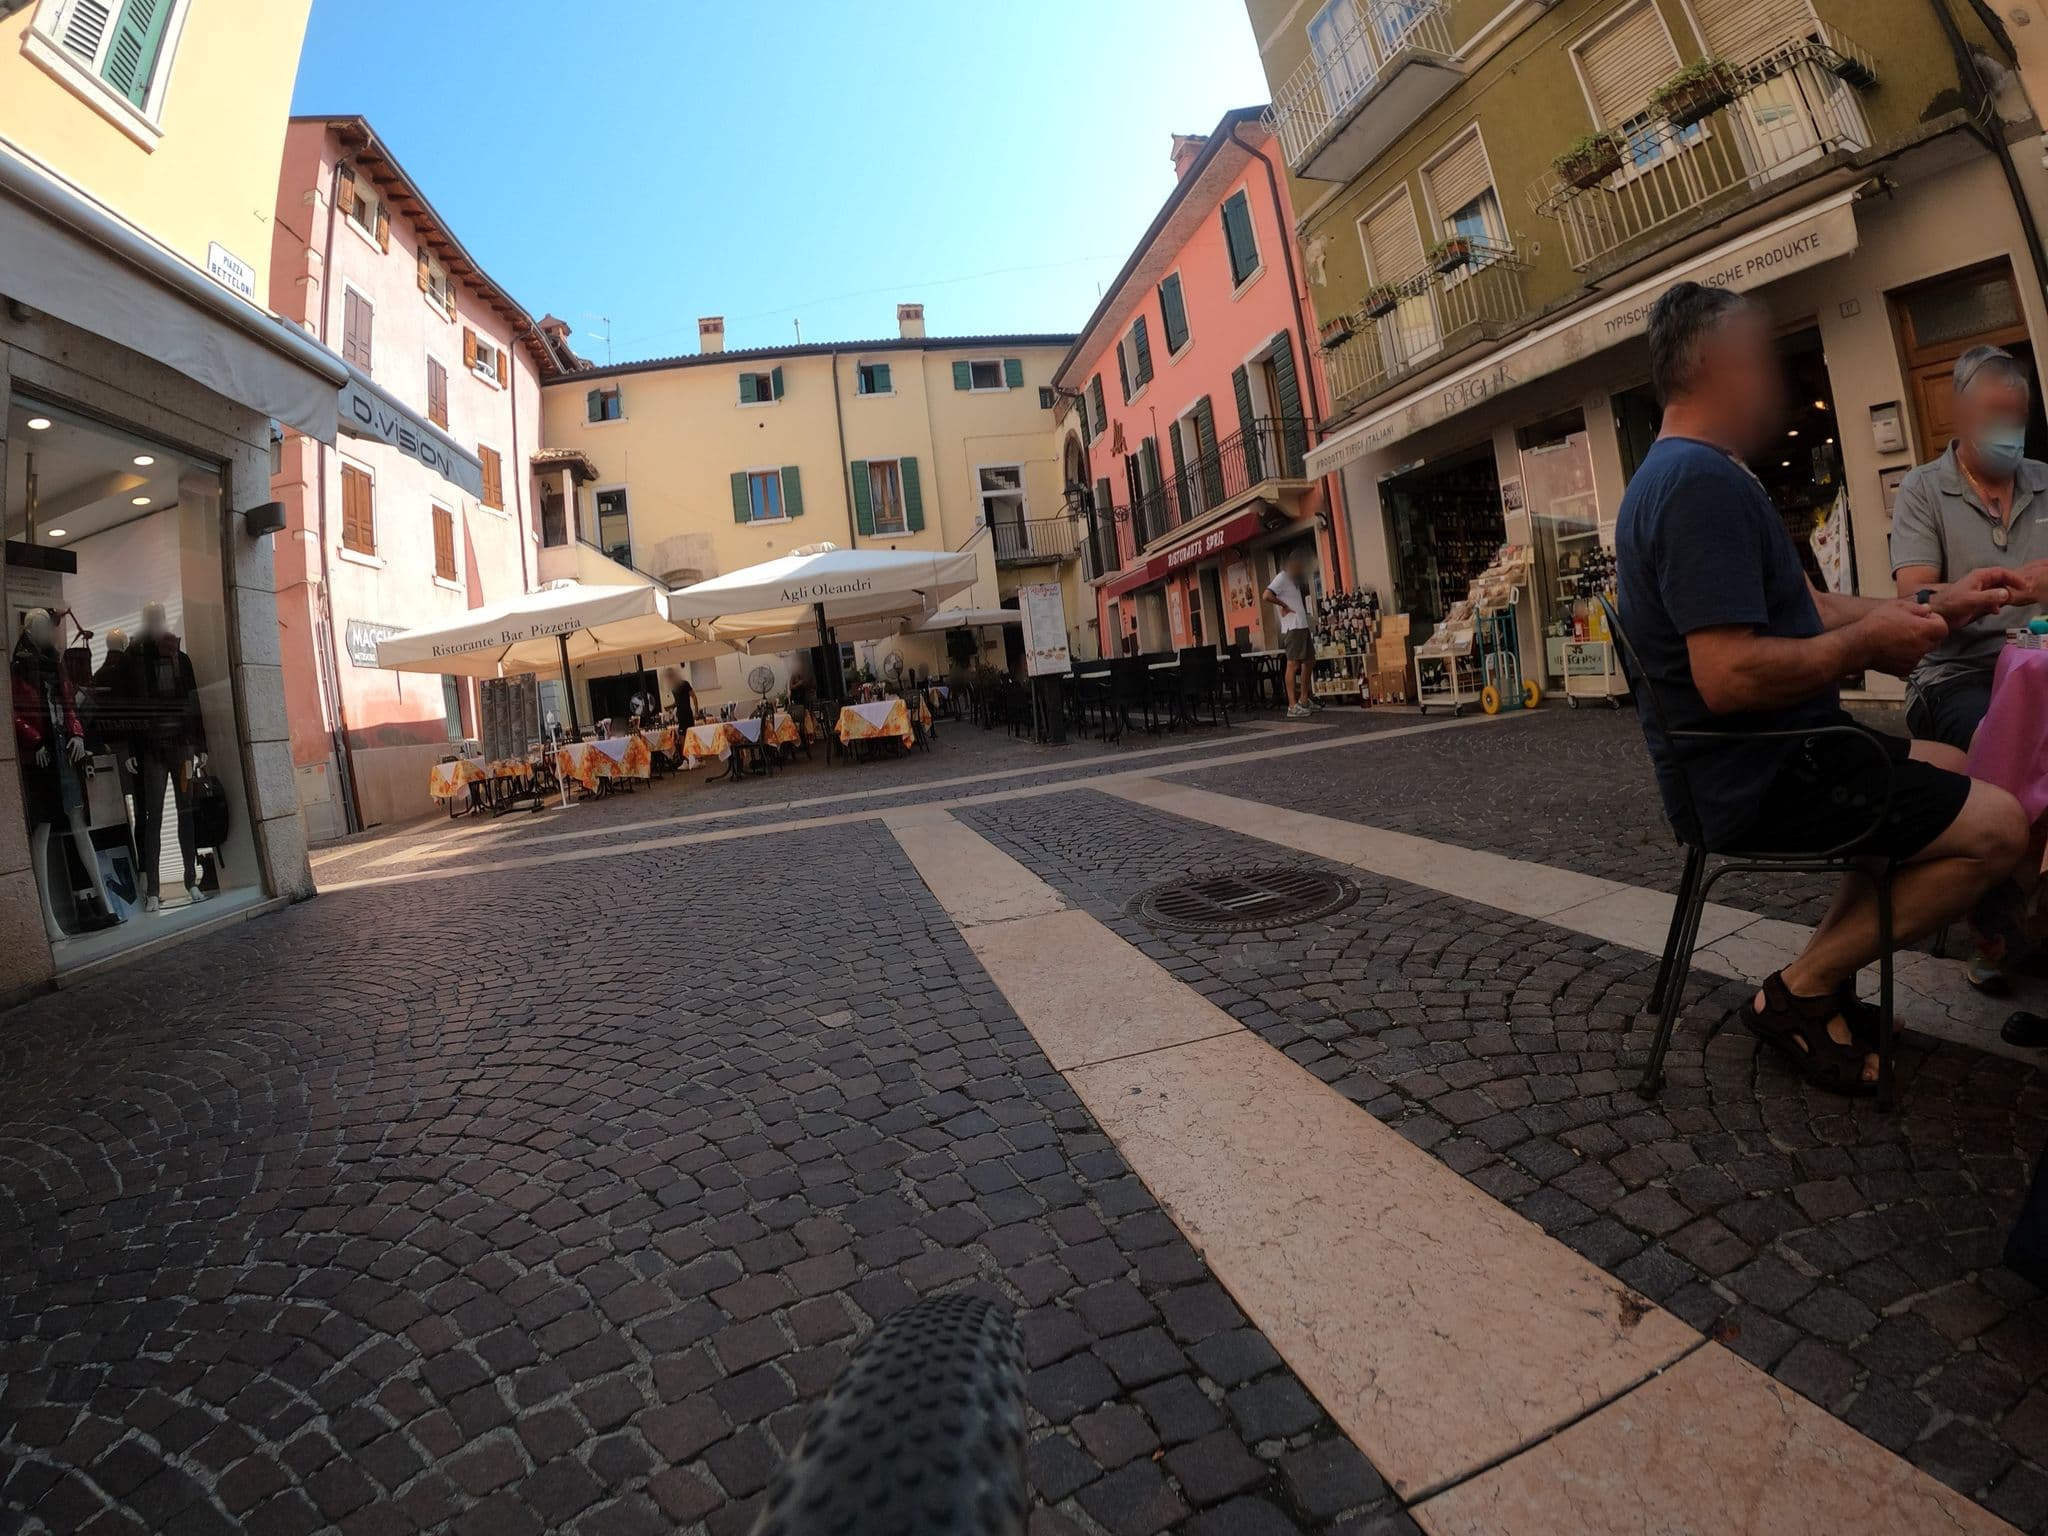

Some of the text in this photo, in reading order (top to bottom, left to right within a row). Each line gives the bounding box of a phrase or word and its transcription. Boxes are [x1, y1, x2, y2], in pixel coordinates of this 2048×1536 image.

[223, 255, 243, 277] PIAZZA
[1747, 232, 1821, 274] PRODUKTE
[211, 262, 252, 297] BETTELONI
[1316, 424, 1394, 470] PRODOTTI TIPICI ITALIANI
[1167, 540, 1202, 567] RISTORANTE
[780, 577, 872, 603] Agli Oleandri
[432, 616, 582, 657] Ristorante Bar Pizzeria
